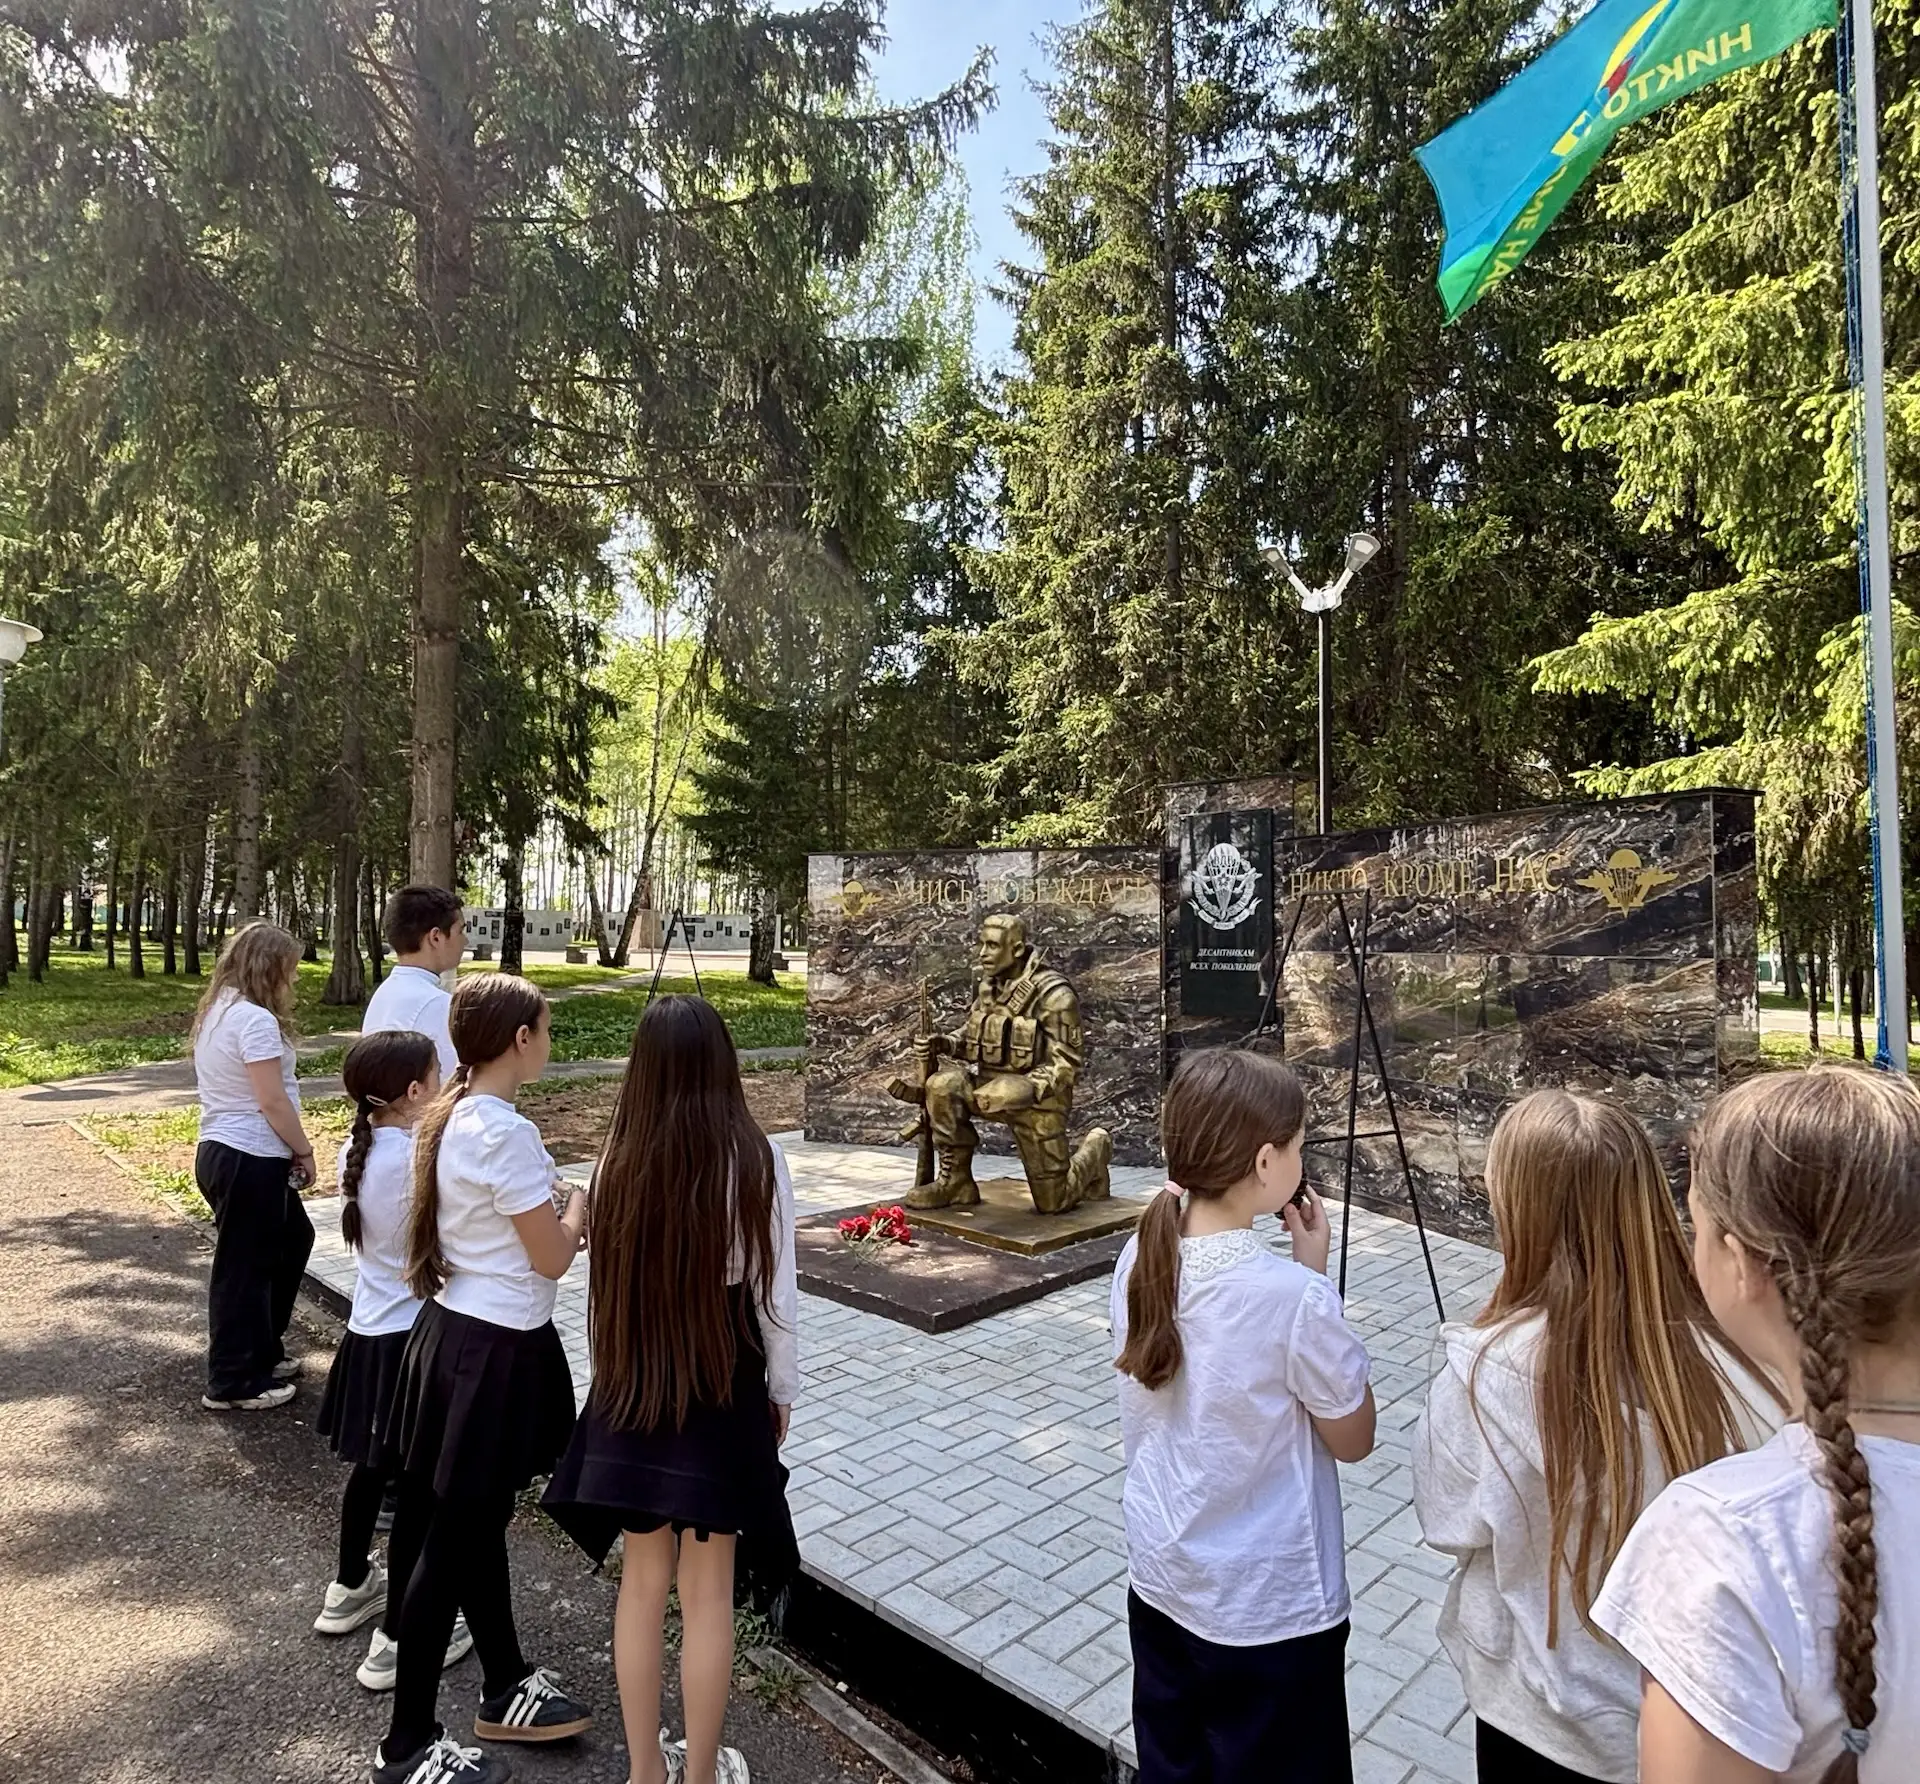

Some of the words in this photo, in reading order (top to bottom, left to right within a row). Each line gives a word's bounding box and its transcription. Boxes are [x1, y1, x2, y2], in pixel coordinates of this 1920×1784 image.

[1289, 867, 1367, 901] НИКТО
[1384, 859, 1476, 898] КРОМЕ
[1493, 853, 1563, 894] НАС
[893, 879, 973, 904] УЧИСЬ
[987, 878, 1151, 909] ПОБЕЖДАТЬ
[1197, 948, 1255, 957] ДЕСАНТНИКАМ
[1190, 962, 1209, 971] ВСЕХ
[1211, 962, 1262, 972] ПОКОЛЕНИЙ
